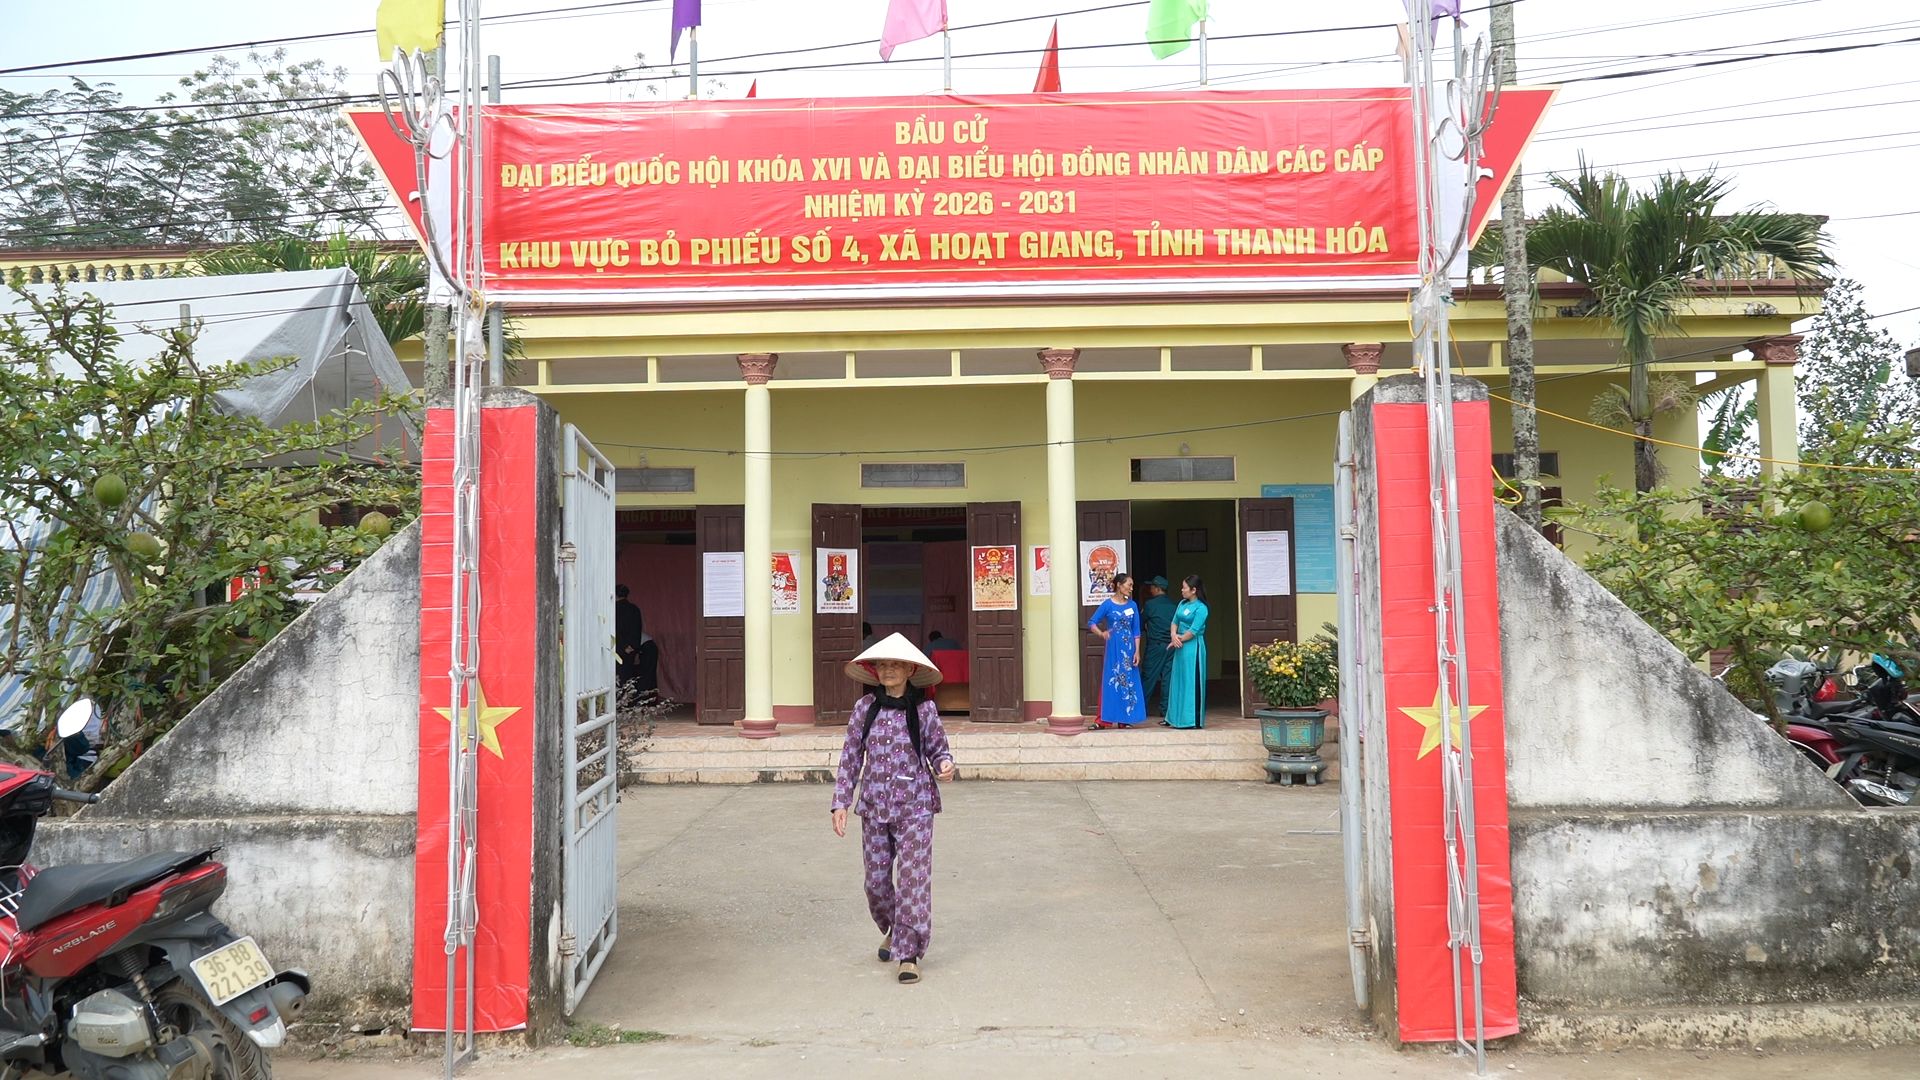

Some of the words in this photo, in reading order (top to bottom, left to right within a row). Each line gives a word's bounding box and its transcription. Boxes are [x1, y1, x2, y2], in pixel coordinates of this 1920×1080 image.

[896, 115, 945, 144] BẦU
[954, 114, 988, 143] CỬ
[501, 164, 543, 192] ĐẠI
[551, 155, 607, 186] BIỂU
[615, 154, 680, 186] QUỐC
[689, 156, 729, 188] HỘI
[739, 155, 804, 182] KHÓA
[813, 158, 851, 181] XVI
[860, 152, 891, 180] VÀ
[898, 156, 940, 183] ĐẠI
[949, 146, 1004, 178] BIỂU
[1013, 150, 1054, 182] HỘI
[1062, 146, 1130, 176] ĐỒNG
[1139, 147, 1209, 175] NHÂN
[1218, 146, 1268, 173] DÂN
[1278, 146, 1326, 173] CÁC
[1335, 141, 1383, 172] CẤP
[805, 189, 885, 222] NHIỆM
[895, 188, 925, 216] KỲ
[934, 192, 993, 215] 2026
[1020, 191, 1075, 213] 2031
[500, 242, 561, 268] KHU
[571, 238, 629, 273] VỰC
[640, 230, 680, 265] BỎ
[691, 229, 780, 265] PHIẾU
[792, 226, 831, 263] SỐ
[842, 236, 868, 264] 4,
[880, 229, 920, 261] XÃ
[931, 232, 1009, 265] HOẠT
[1020, 230, 1123, 260] GIANG,
[1133, 221, 1203, 256] TỈNH
[1213, 228, 1315, 255] THANH
[1326, 221, 1388, 253] HÓA
[52, 920, 117, 956] AIRBLADE
[203, 943, 252, 979] 36-B8
[210, 959, 269, 1001] 221.39
